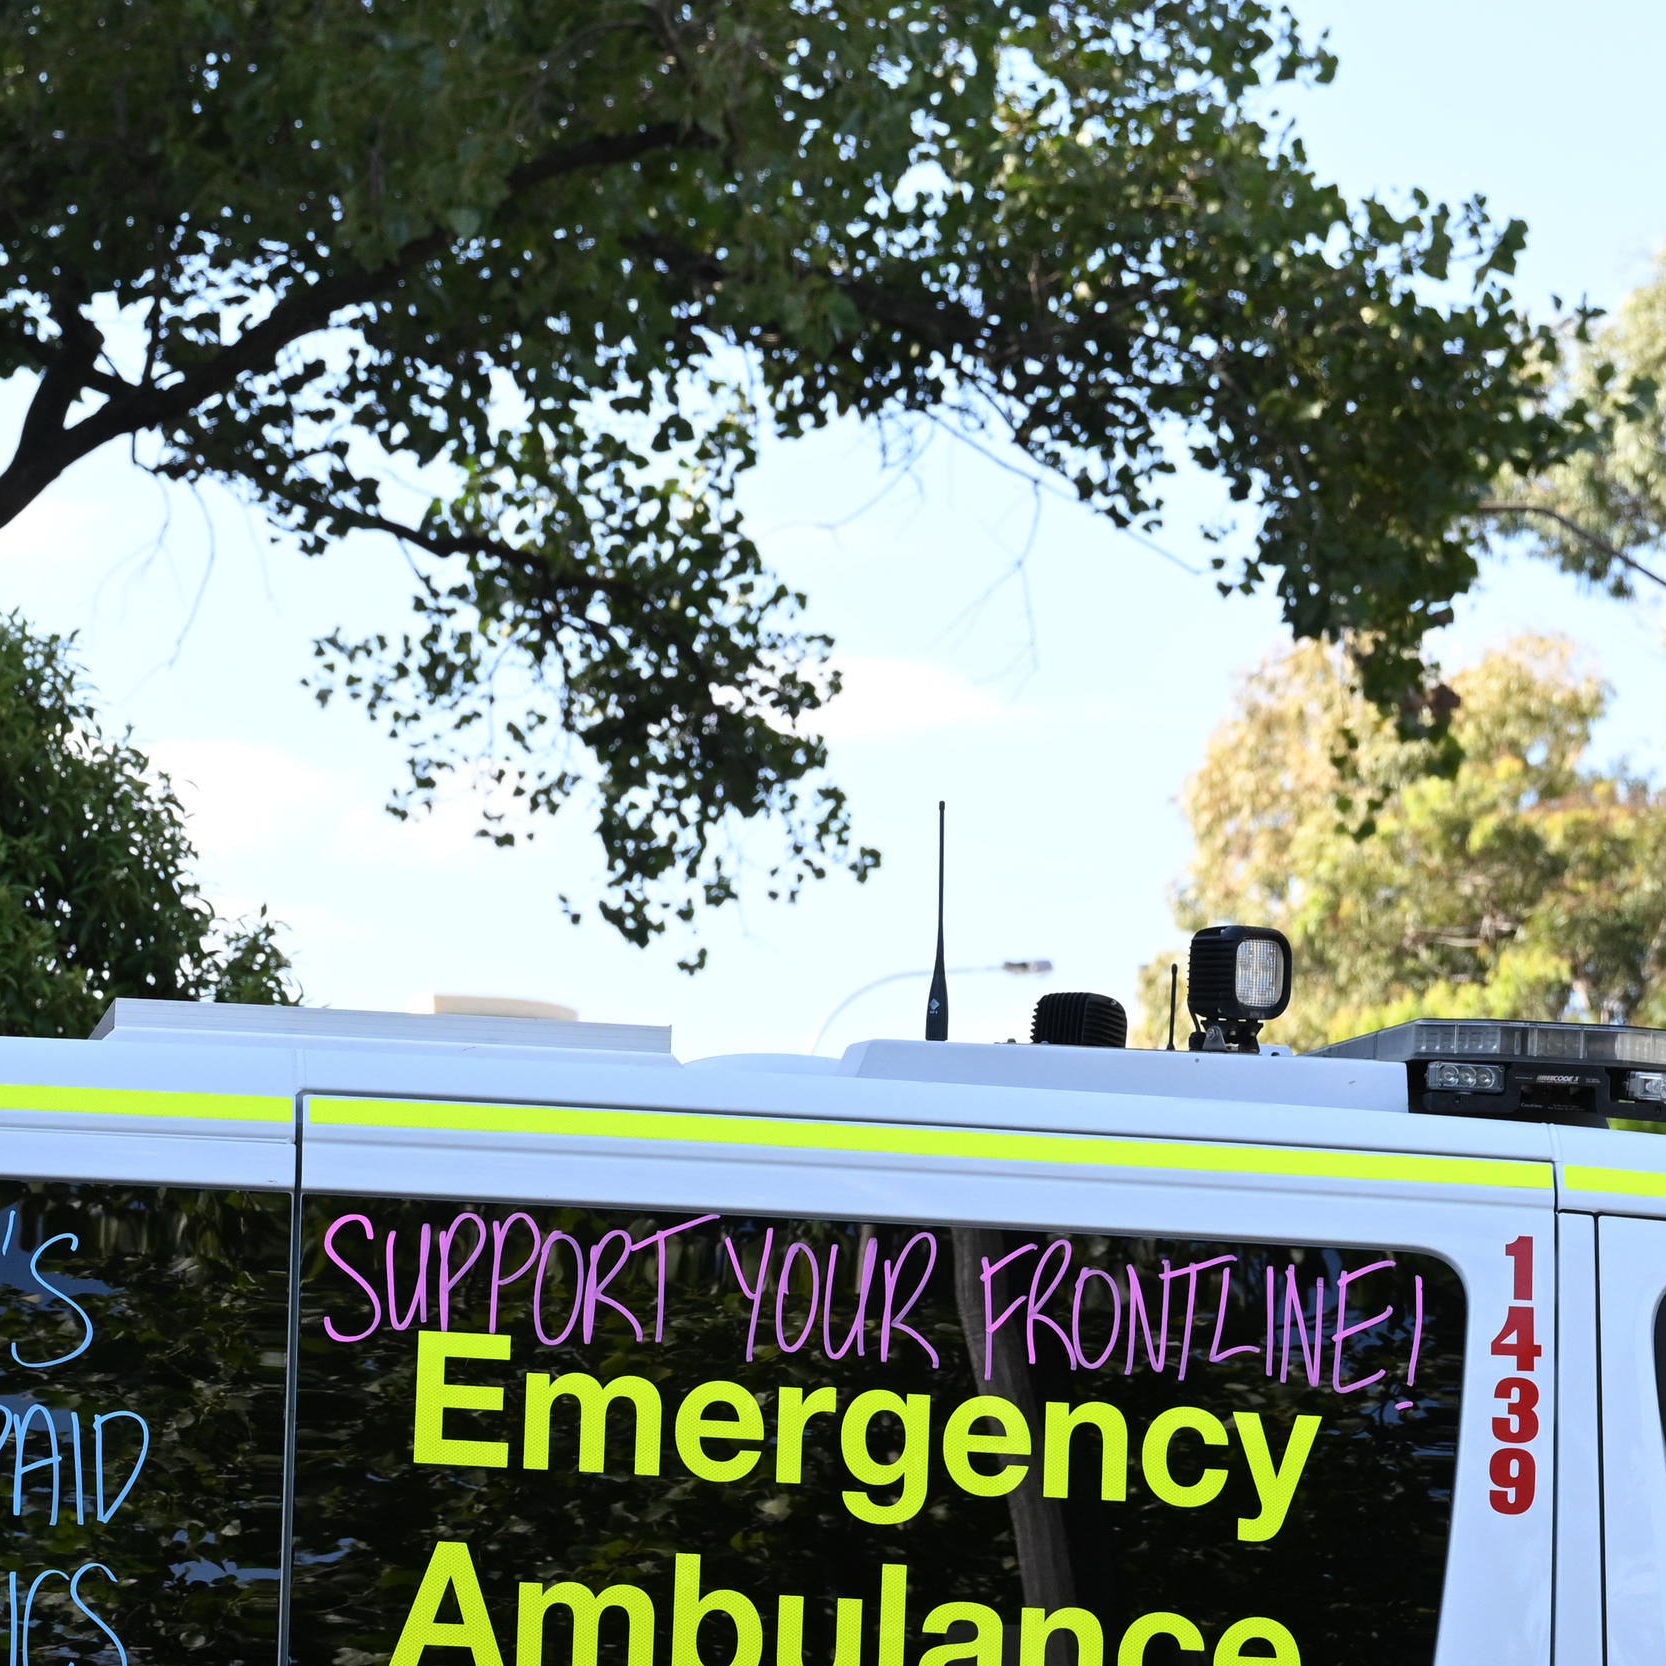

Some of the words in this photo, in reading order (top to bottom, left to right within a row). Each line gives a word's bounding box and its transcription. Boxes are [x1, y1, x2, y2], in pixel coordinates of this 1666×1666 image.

[323, 1212, 720, 1345] SUPPORT
[725, 1228, 939, 1369] YOUR
[981, 1238, 1423, 1410] FRONTLINE!
[1488, 1235, 1544, 1515] 1439
[413, 1330, 1323, 1543] Emergency
